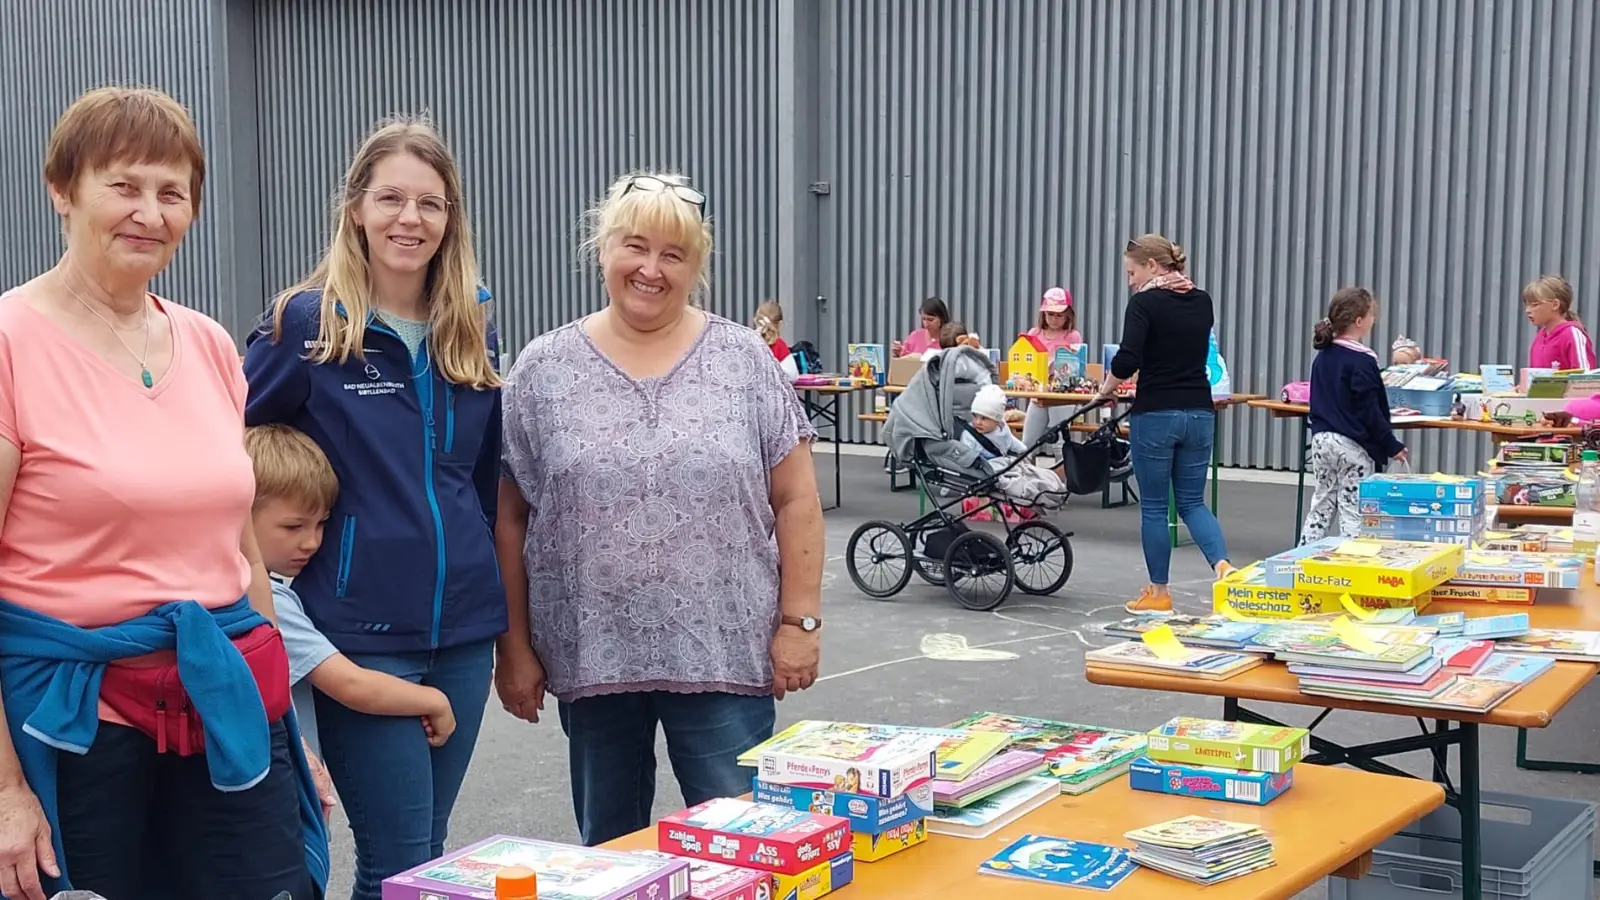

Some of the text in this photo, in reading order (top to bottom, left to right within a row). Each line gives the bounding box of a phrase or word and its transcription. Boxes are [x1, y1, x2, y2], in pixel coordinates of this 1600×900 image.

[1298, 572, 1405, 588] Ratz-Fatz HABA
[1227, 587, 1291, 601] Mein erster
[668, 829, 696, 843] Zahlen
[681, 839, 703, 854] Spaß
